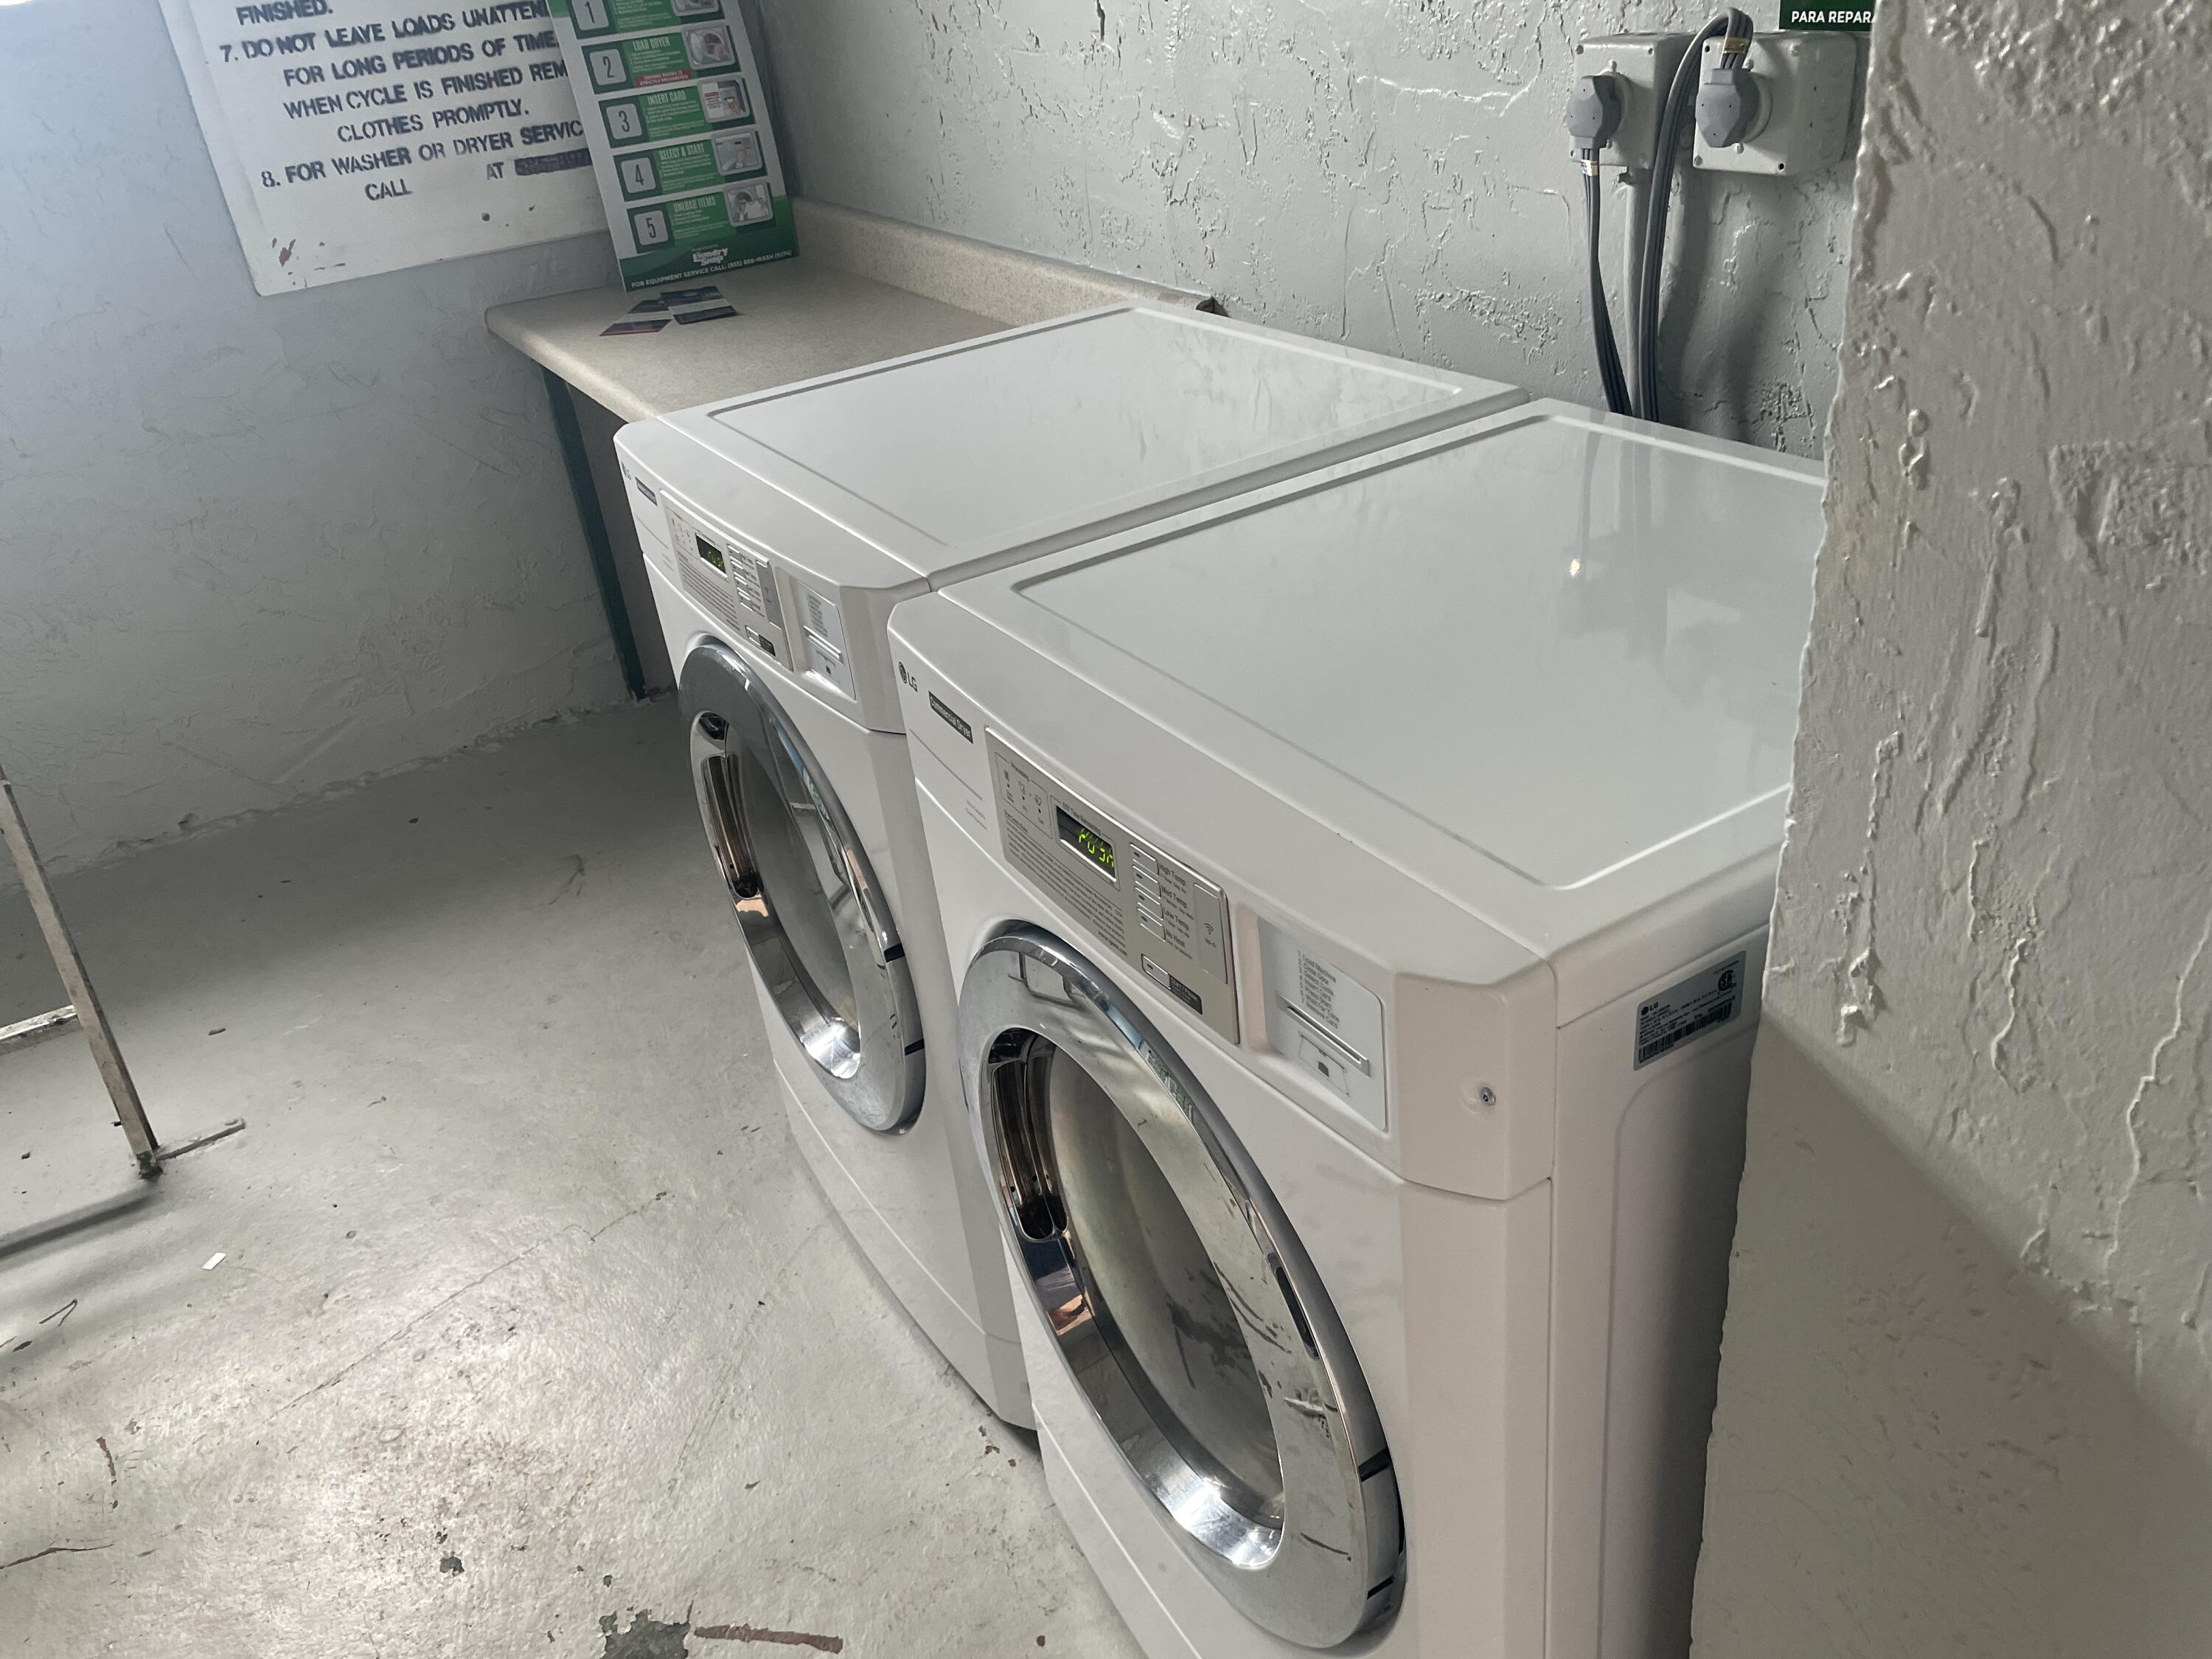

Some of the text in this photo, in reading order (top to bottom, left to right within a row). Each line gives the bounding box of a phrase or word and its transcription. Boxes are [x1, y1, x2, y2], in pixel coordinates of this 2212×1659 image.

[1792, 10, 1826, 24] PARA
[220, 44, 238, 62] 7.
[242, 38, 274, 59] DO
[276, 32, 316, 55] NOT
[325, 23, 386, 47] LEAVE
[392, 13, 456, 38] LOADS
[283, 65, 324, 87] FOR
[331, 55, 386, 80] LONG
[392, 43, 474, 70] PERIODS
[481, 38, 506, 58] OF
[602, 55, 614, 78] 2
[283, 94, 344, 119] WHEN
[346, 85, 408, 109] CYCLE
[414, 80, 434, 100] IS
[441, 66, 523, 95] FINISHED
[337, 98, 529, 142] CLOTHES PROMPTLY.
[618, 111, 630, 133] 3
[261, 170, 281, 187] 8.
[285, 160, 327, 184] FOR
[331, 147, 412, 175] WASHER
[418, 142, 446, 161] OR
[453, 131, 514, 156] DRYER
[365, 178, 413, 201] CALL
[487, 161, 504, 181] AT
[635, 164, 644, 186] 4
[645, 218, 656, 238] 5
[631, 280, 644, 288] FOR
[646, 273, 683, 285] EQUIPMENT
[684, 267, 709, 279] SERVICE
